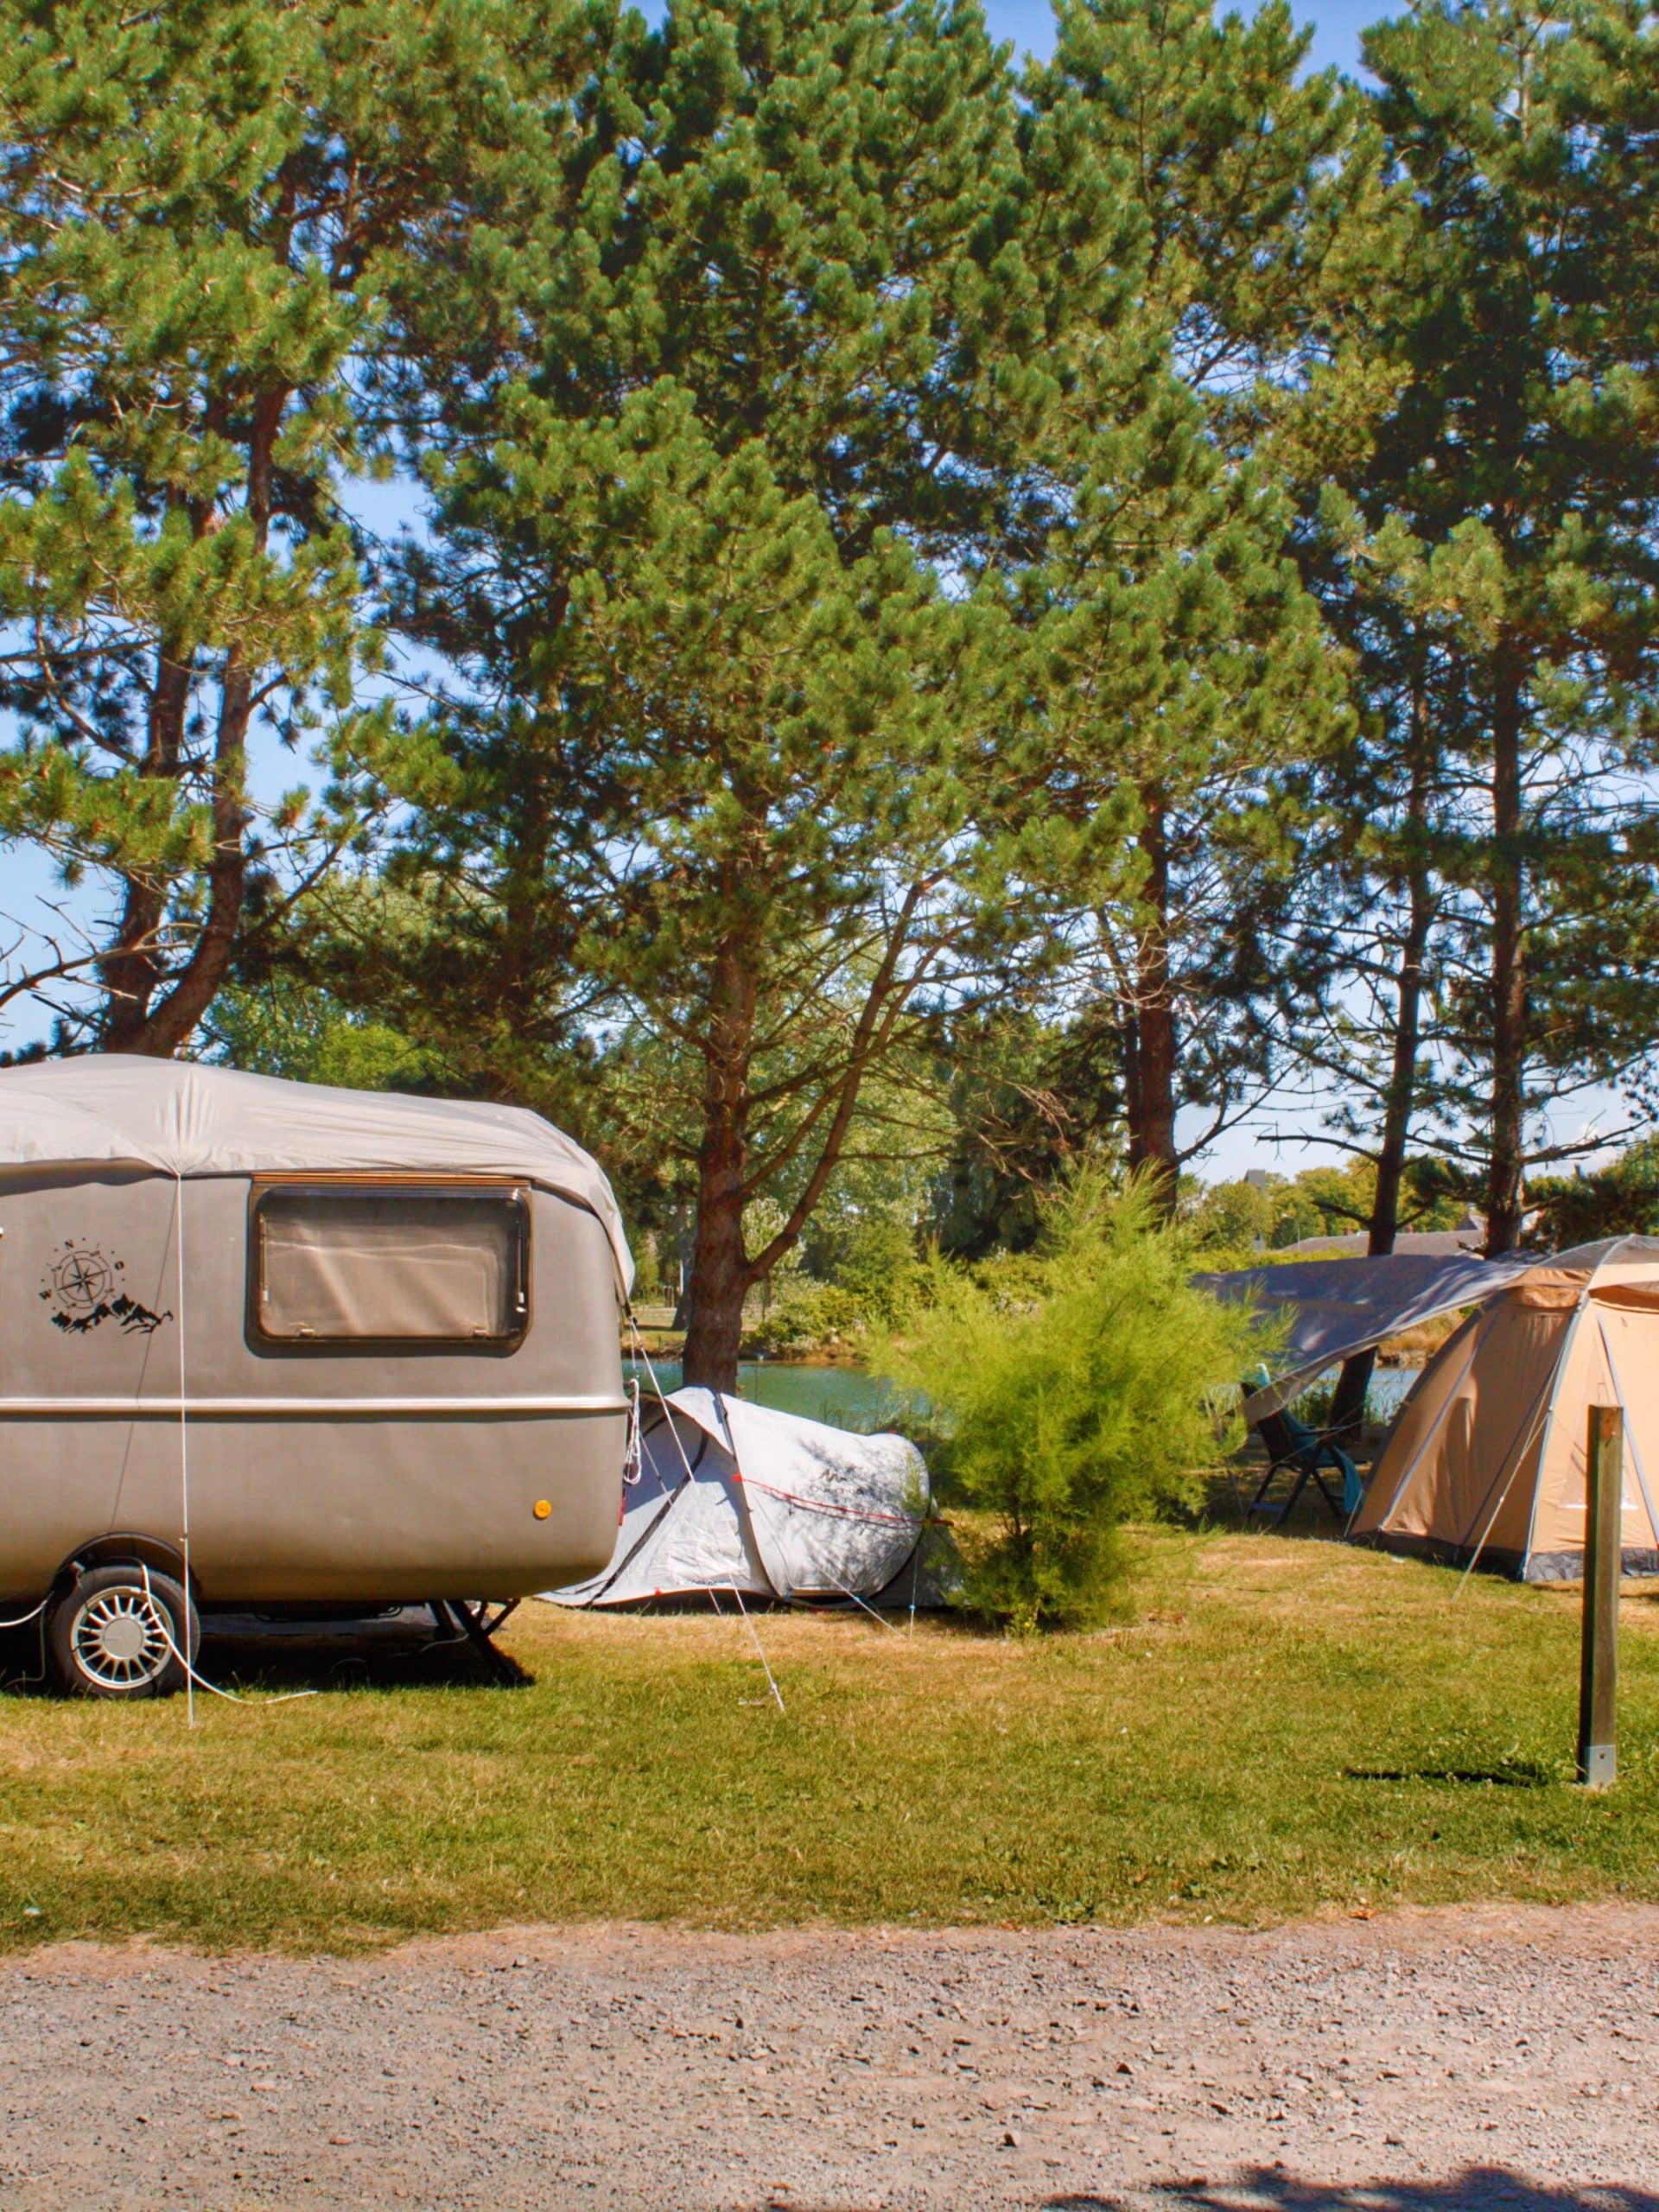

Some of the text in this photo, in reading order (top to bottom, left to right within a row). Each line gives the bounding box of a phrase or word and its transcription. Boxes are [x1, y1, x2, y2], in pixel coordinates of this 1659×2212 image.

[65, 1240, 73, 1249] N
[114, 1261, 124, 1270] O
[40, 1288, 52, 1300] W
